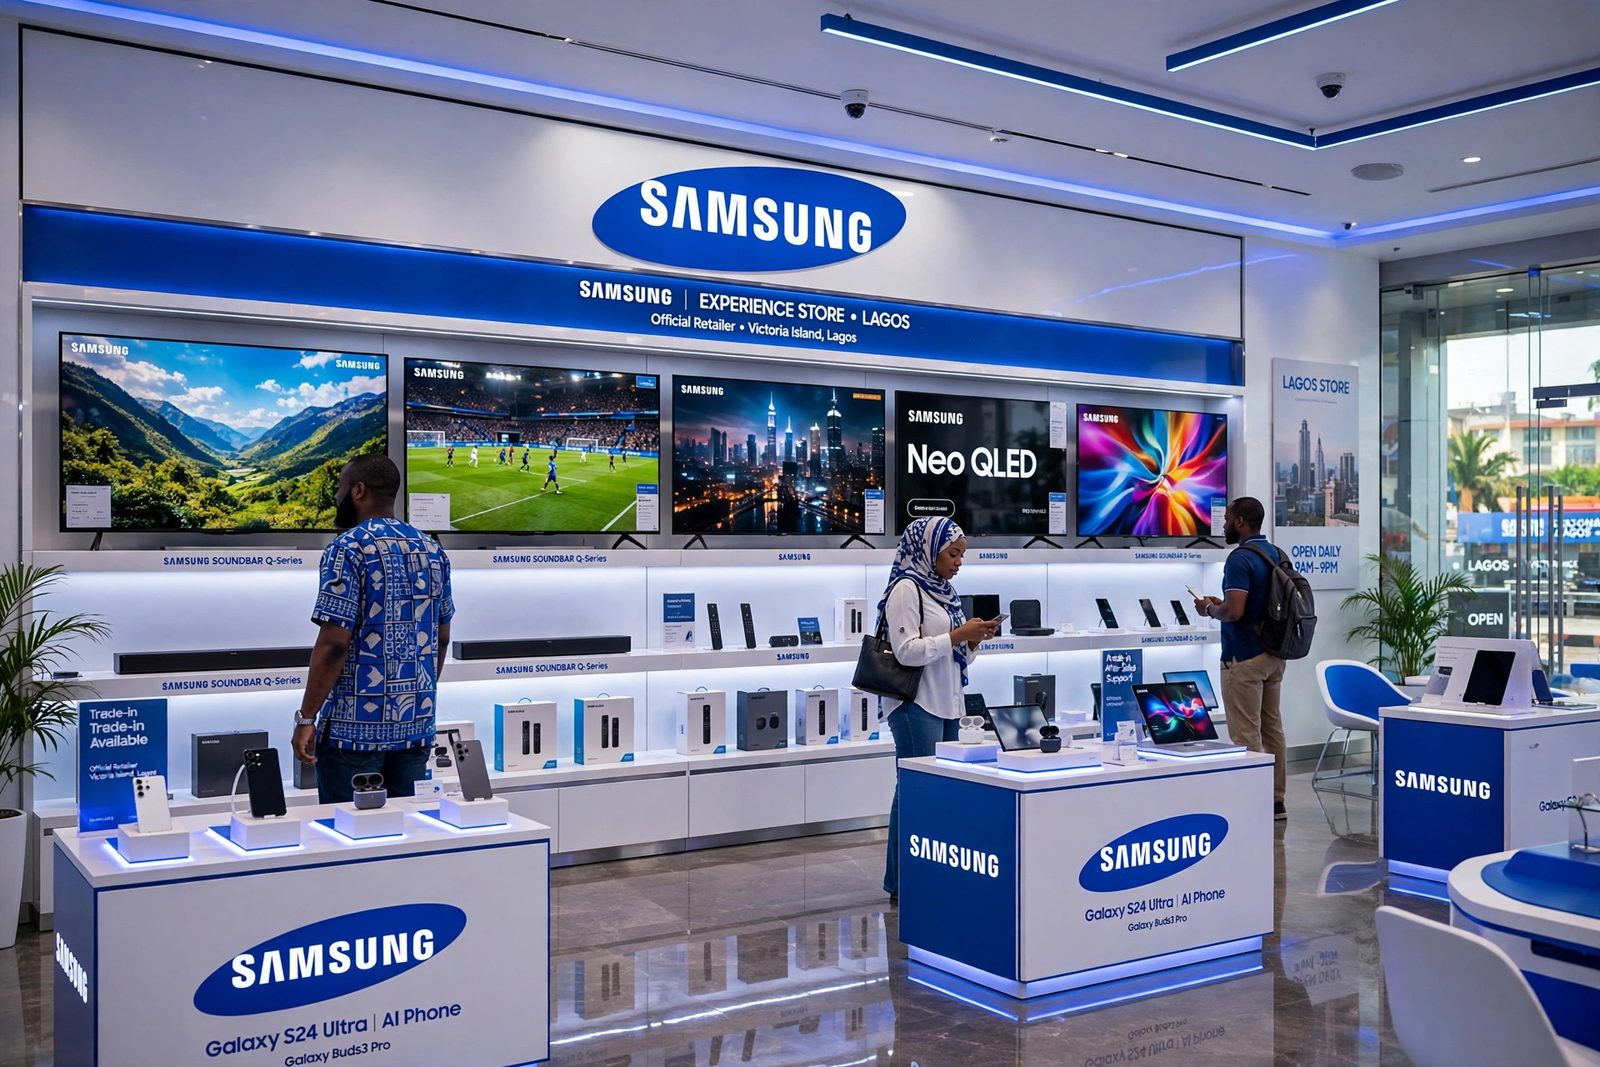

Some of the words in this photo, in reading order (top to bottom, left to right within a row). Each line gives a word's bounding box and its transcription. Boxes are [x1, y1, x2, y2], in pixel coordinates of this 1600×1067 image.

[640, 179, 872, 253] SAMSUNG
[579, 280, 672, 305] SAMSUNG
[699, 293, 794, 319] EXPERIENCE
[798, 302, 845, 323] STORE
[862, 310, 911, 330] LAGOS
[651, 313, 691, 328] Official
[694, 316, 735, 332] Retailer
[748, 322, 789, 337] Victoria
[791, 326, 825, 342] Island,
[827, 329, 857, 345] Lagos
[71, 342, 129, 356] SAMSUNG
[336, 359, 380, 370] SAMSUNG
[414, 367, 465, 380] SAMSUNG
[680, 384, 724, 396] SAMSUNG
[1282, 375, 1317, 392] LAGOS
[1320, 379, 1349, 394] STORE
[908, 409, 964, 425] SAMSUNG
[1083, 413, 1119, 424] SAMSUNG
[907, 443, 965, 476] Neo
[971, 446, 1037, 479] QLED
[493, 555, 531, 564] SAMSUNG
[533, 554, 575, 564] SOUNDBAR
[576, 553, 607, 565] Q-Series
[1291, 545, 1317, 558] OPEN
[1318, 545, 1342, 557] DAILY
[163, 556, 210, 565] SAMSUNG
[212, 555, 264, 565] SOUNDBAR
[265, 555, 303, 567] Q-Series
[1468, 559, 1510, 571] LAGOS
[1467, 612, 1503, 626] OPEN
[496, 665, 534, 675] SAMSUNG
[535, 663, 576, 673] SOUNDBAR
[577, 661, 608, 672] Q-Series
[161, 680, 209, 691] SAMSUNG
[211, 678, 262, 688] SOUNDBAR
[263, 676, 301, 687] Q-Series
[89, 707, 138, 720] Trade-in
[89, 721, 145, 734] Trade-in
[89, 734, 149, 749] Available
[1395, 769, 1491, 800] SAMSUNG
[909, 834, 999, 878] SAMSUNG
[1100, 832, 1212, 872] SAMSUNG
[1084, 905, 1126, 923] Galaxy
[1127, 901, 1147, 916] S24
[1148, 897, 1174, 913] Ultra
[1181, 893, 1192, 907] AI
[1193, 888, 1226, 904] Phone
[1127, 920, 1154, 933] Galaxy
[1154, 917, 1175, 928] Buds3
[1176, 914, 1188, 924] Pro
[231, 928, 434, 989] SAMSUNG
[55, 932, 89, 1004] SAMSUNG
[205, 1030, 280, 1059] Galaxy
[283, 1024, 318, 1045] S24
[322, 1016, 368, 1039] Ultra
[382, 1011, 400, 1028] AI
[403, 1003, 462, 1025] Phone
[284, 1049, 330, 1067] Galaxy
[332, 1042, 369, 1059] Buds3
[371, 1039, 391, 1054] Pro
